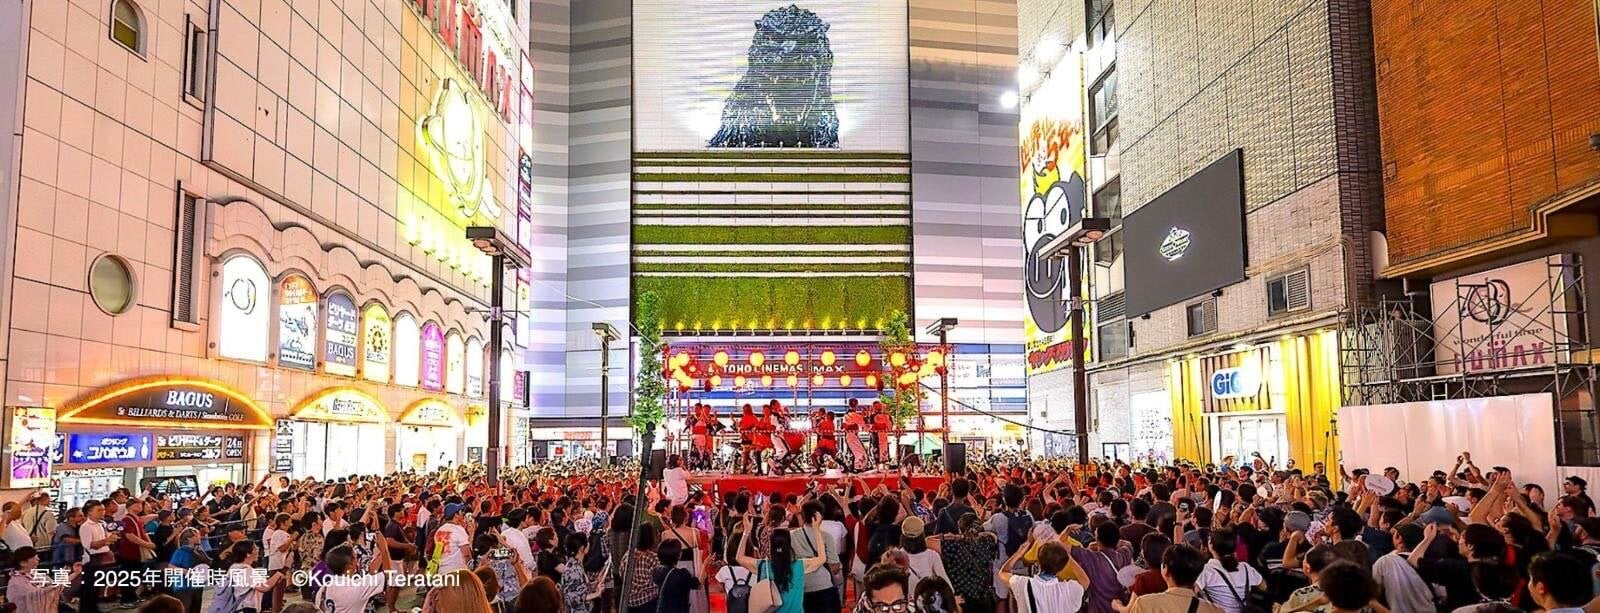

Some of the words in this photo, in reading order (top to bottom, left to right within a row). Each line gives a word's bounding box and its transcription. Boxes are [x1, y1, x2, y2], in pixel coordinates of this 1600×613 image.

[723, 364, 752, 373] TOHO
[166, 390, 214, 408] BAGUS
[128, 407, 168, 418] BILLIARDS
[175, 409, 198, 420] DARTS
